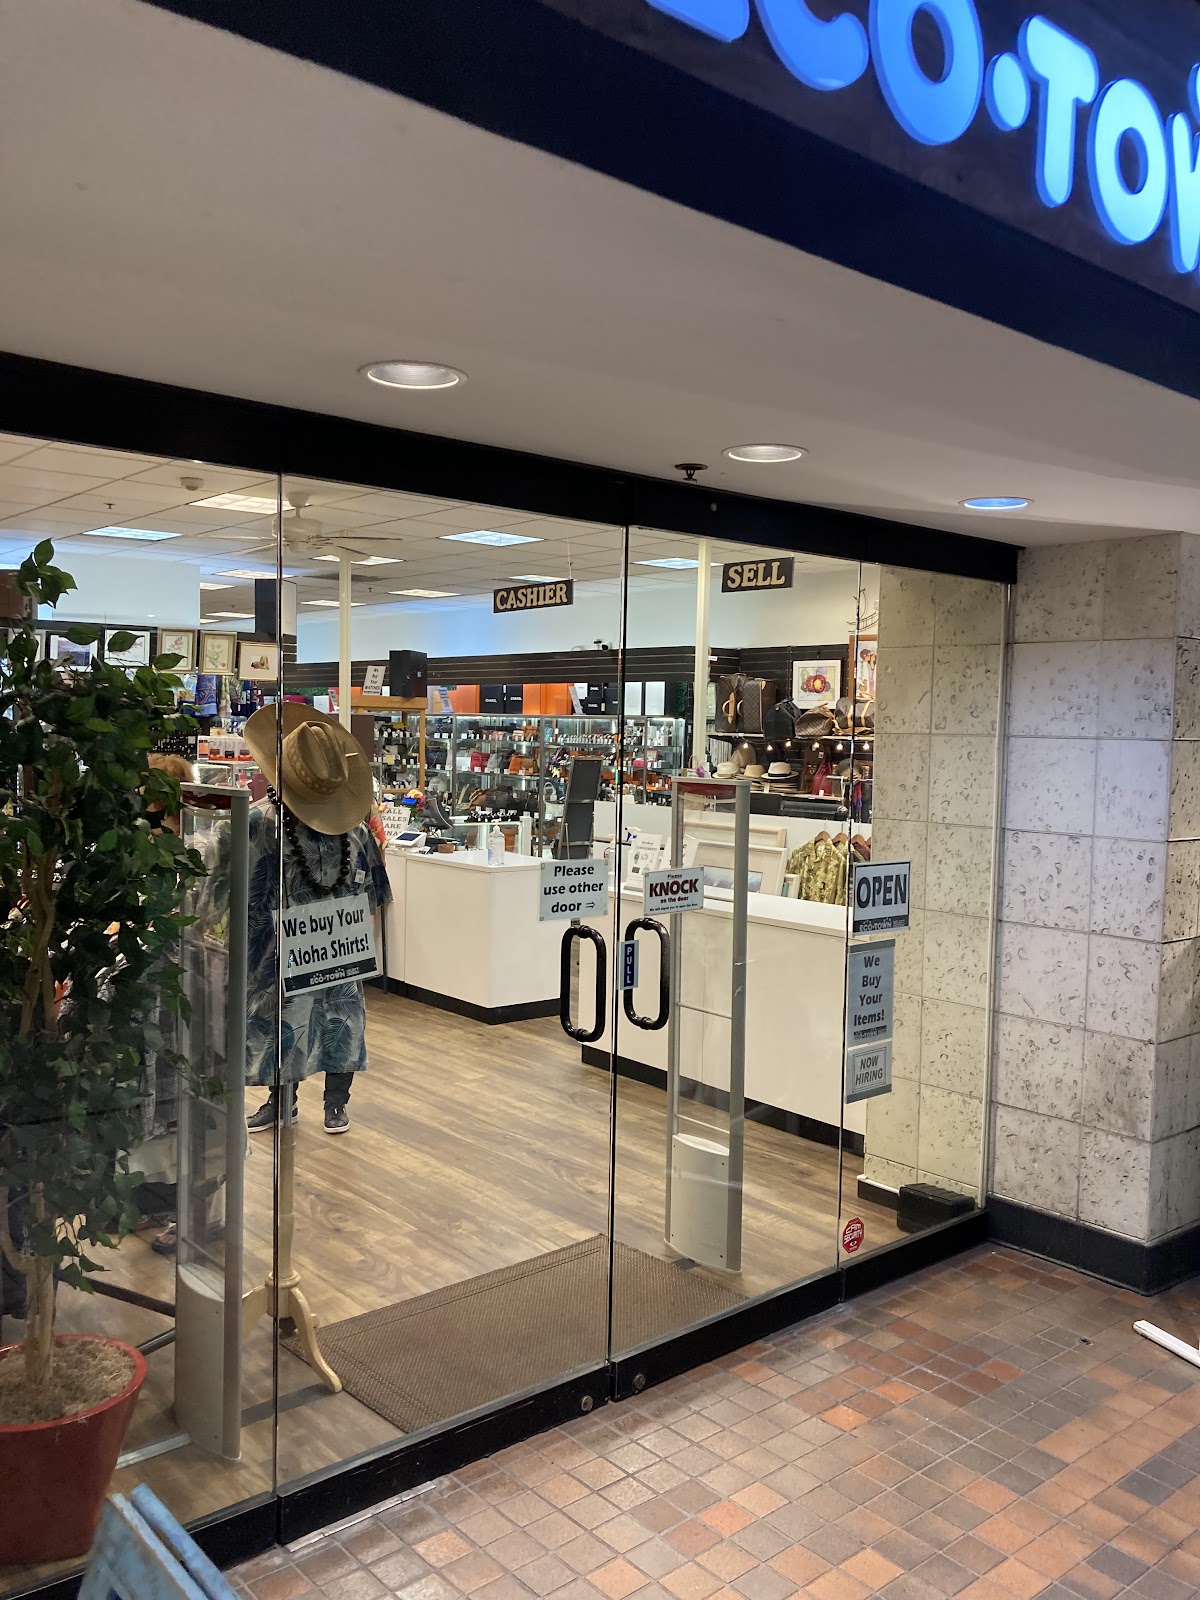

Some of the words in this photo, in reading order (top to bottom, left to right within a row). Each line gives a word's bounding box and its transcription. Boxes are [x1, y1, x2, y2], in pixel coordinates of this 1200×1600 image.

[726, 561, 786, 589] SELL
[495, 583, 568, 611] CASHIER
[553, 865, 595, 877] Please
[543, 884, 566, 896] use
[568, 881, 604, 894] other
[649, 878, 699, 898] KNOCK
[856, 873, 908, 909] OPEN
[551, 901, 582, 913] door
[282, 917, 307, 938] We
[309, 915, 334, 936] buy
[336, 908, 365, 927] Your
[287, 944, 329, 969] Aloha
[330, 933, 370, 959] Shirts!
[863, 955, 880, 968] We
[861, 975, 882, 989] Buy
[859, 993, 883, 1007] Your
[853, 1008, 885, 1027] Items!
[860, 1054, 880, 1070] NOW
[855, 1067, 883, 1086] HIRING
